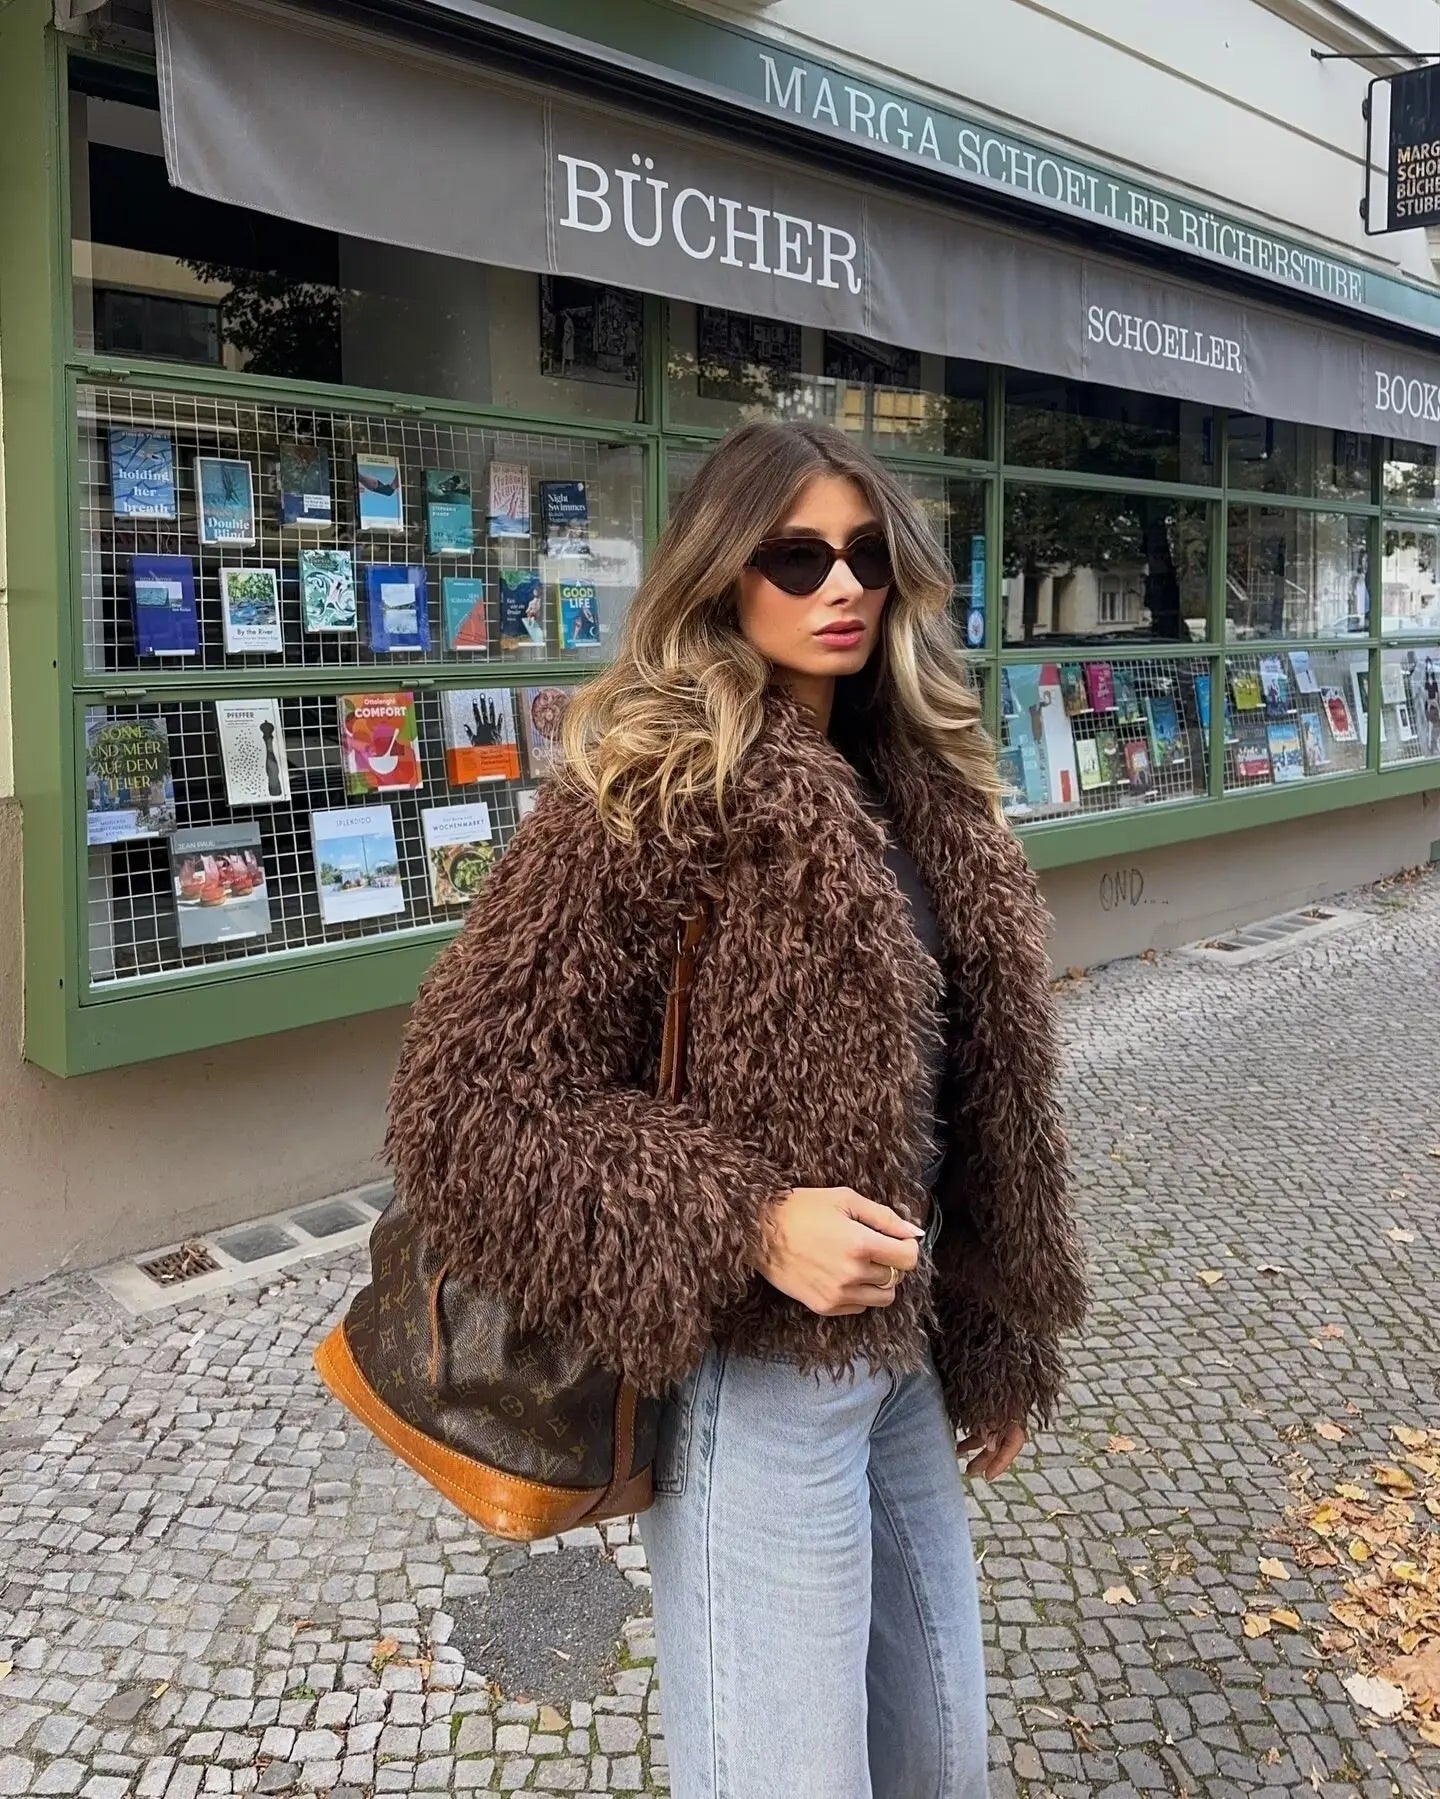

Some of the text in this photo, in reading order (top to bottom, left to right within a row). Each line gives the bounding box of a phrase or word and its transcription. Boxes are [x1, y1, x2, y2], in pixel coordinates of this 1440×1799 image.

[759, 54, 1362, 303] MARGA SCHOELLER BÜCHERSTUBE
[558, 153, 862, 294] BÜCHER
[1088, 305, 1242, 374] SCHOELLER
[1375, 370, 1440, 422] BOOK
[119, 468, 169, 483] holding
[133, 486, 157, 497] her
[548, 493, 569, 503] Night
[123, 501, 168, 514] breath
[548, 503, 586, 511] Swimmers
[207, 516, 250, 530] Double
[563, 587, 594, 598] GOOD
[569, 598, 591, 608] LIFE
[237, 629, 245, 637] By
[227, 711, 255, 719] PFEFFER
[355, 706, 407, 718] COMFORT
[123, 741, 162, 756] MEER
[126, 758, 158, 773] DEM
[433, 819, 485, 831] WOCHENMARKT
